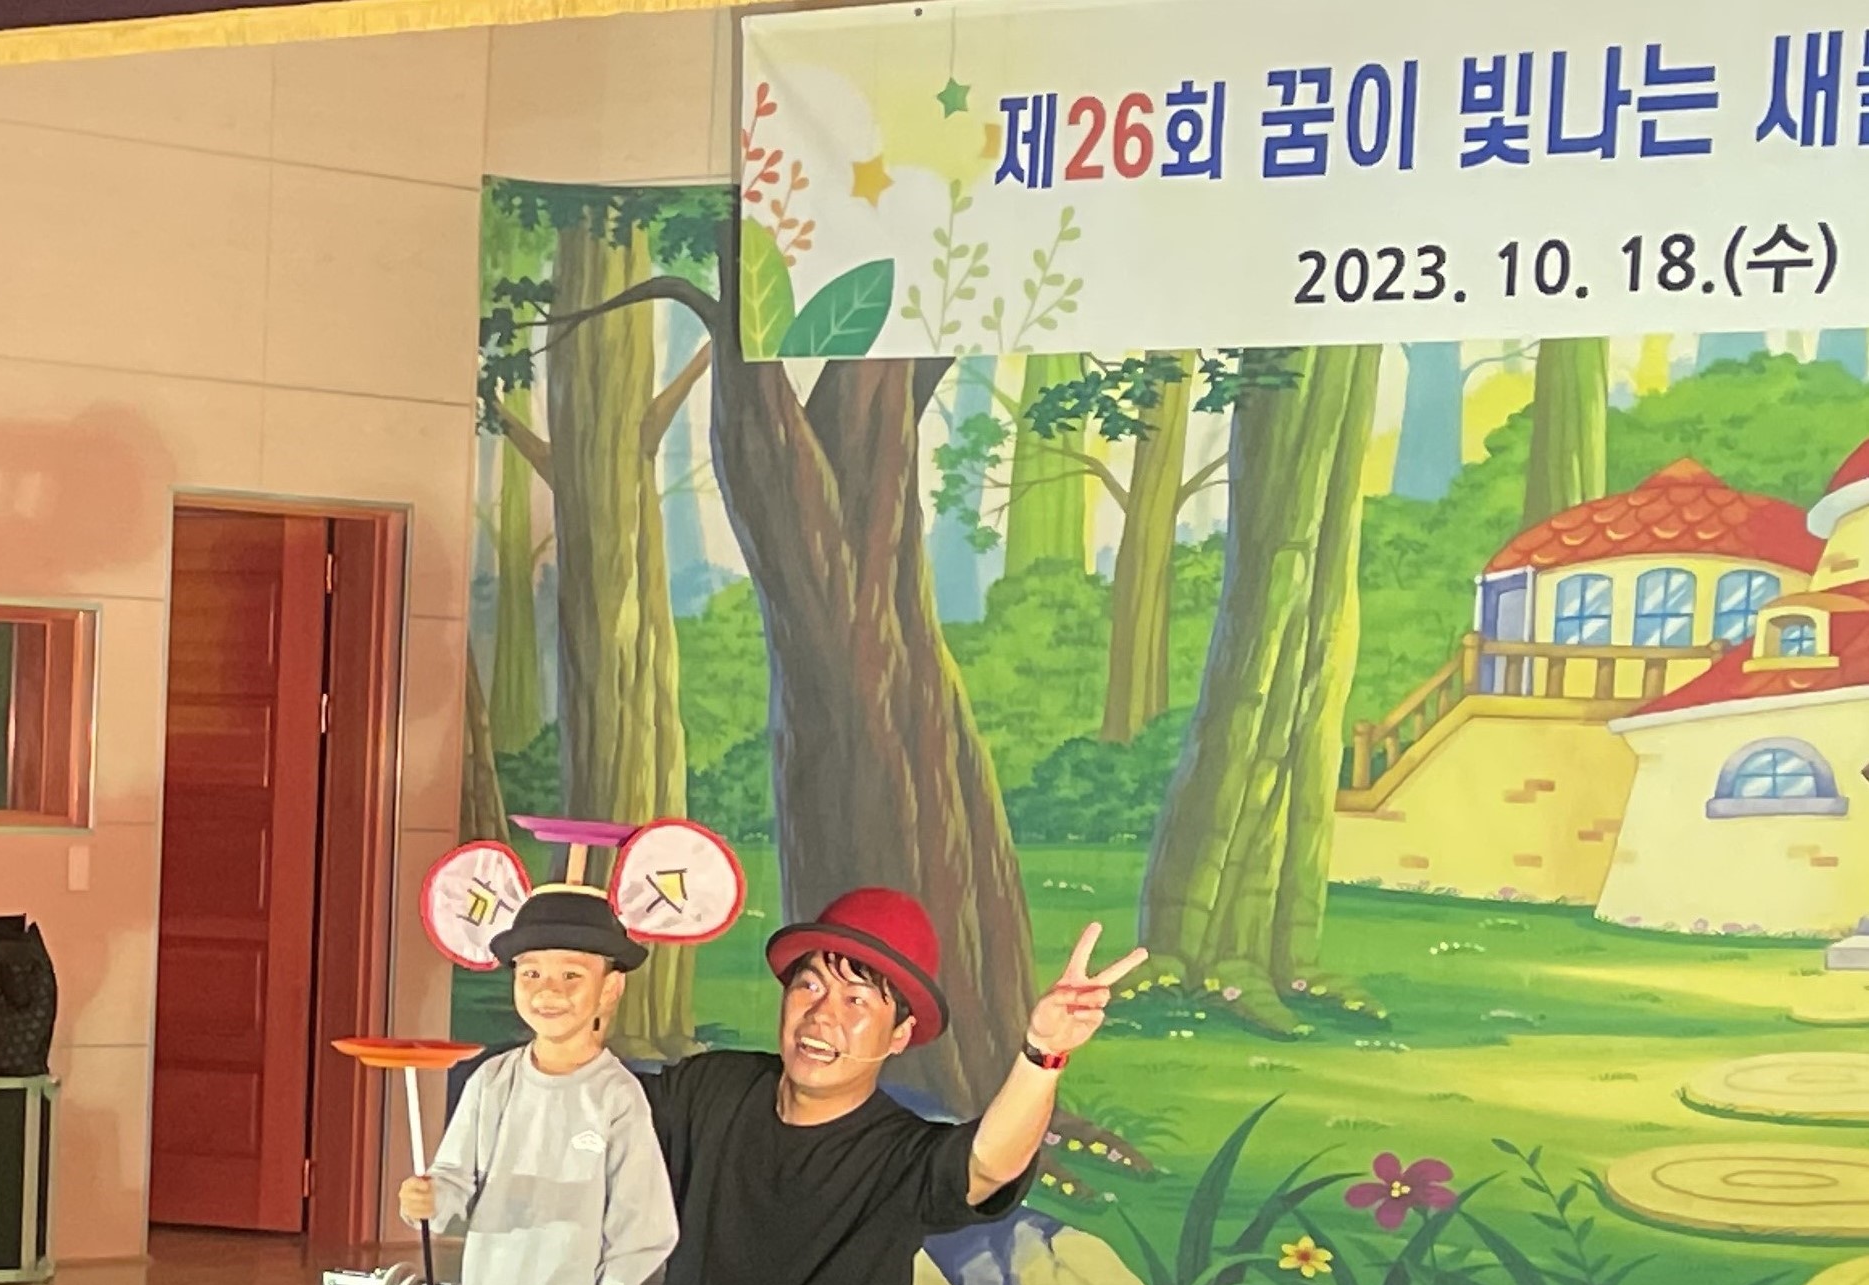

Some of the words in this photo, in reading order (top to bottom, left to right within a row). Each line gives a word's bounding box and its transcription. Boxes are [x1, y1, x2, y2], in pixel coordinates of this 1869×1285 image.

[994, 80, 1227, 189] 제26회
[1261, 59, 1419, 179] 꿈이
[1460, 43, 1719, 169] 빛나는
[1294, 244, 1467, 304] 2023.
[1497, 238, 1589, 300] 10.
